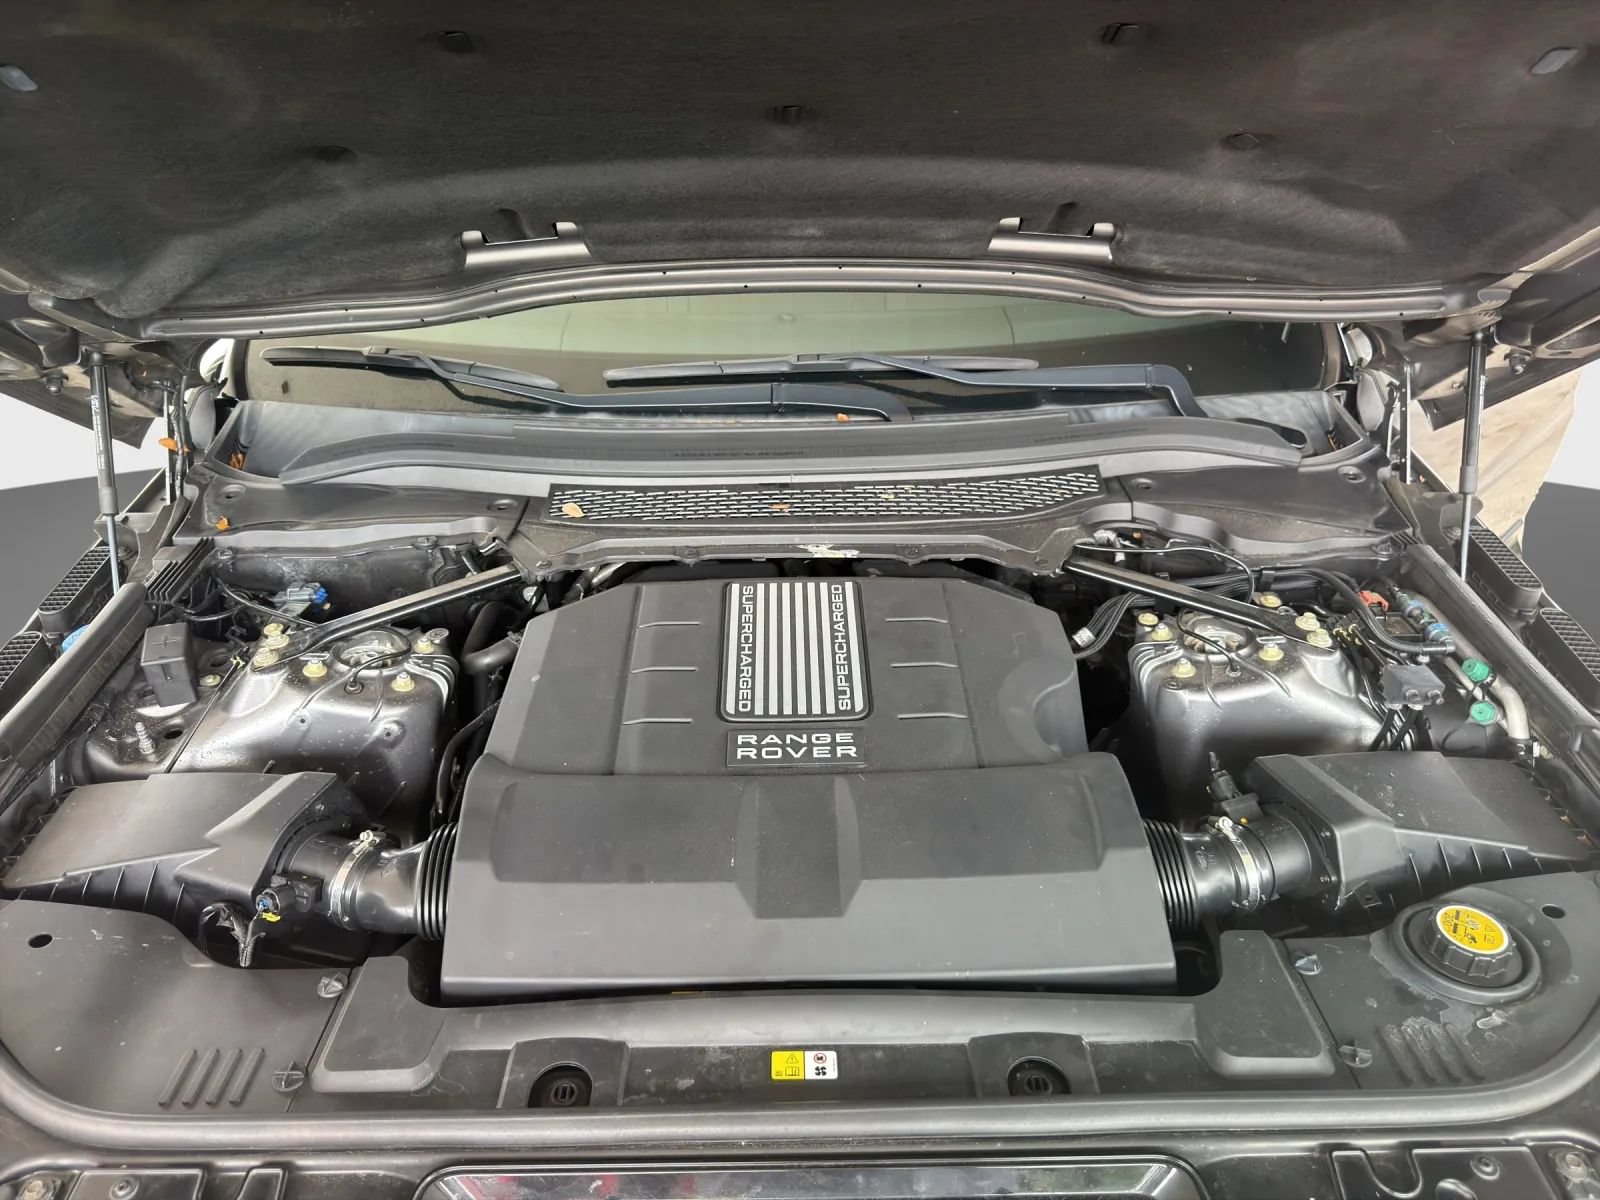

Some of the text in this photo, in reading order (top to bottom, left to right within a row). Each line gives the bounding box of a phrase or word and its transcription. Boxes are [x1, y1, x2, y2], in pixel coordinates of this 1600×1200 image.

[738, 585, 754, 712] SUPERCHARGED
[831, 584, 851, 711] SUPERCHARGED
[736, 746, 858, 759] ROVER
[737, 733, 854, 745] RANGE
